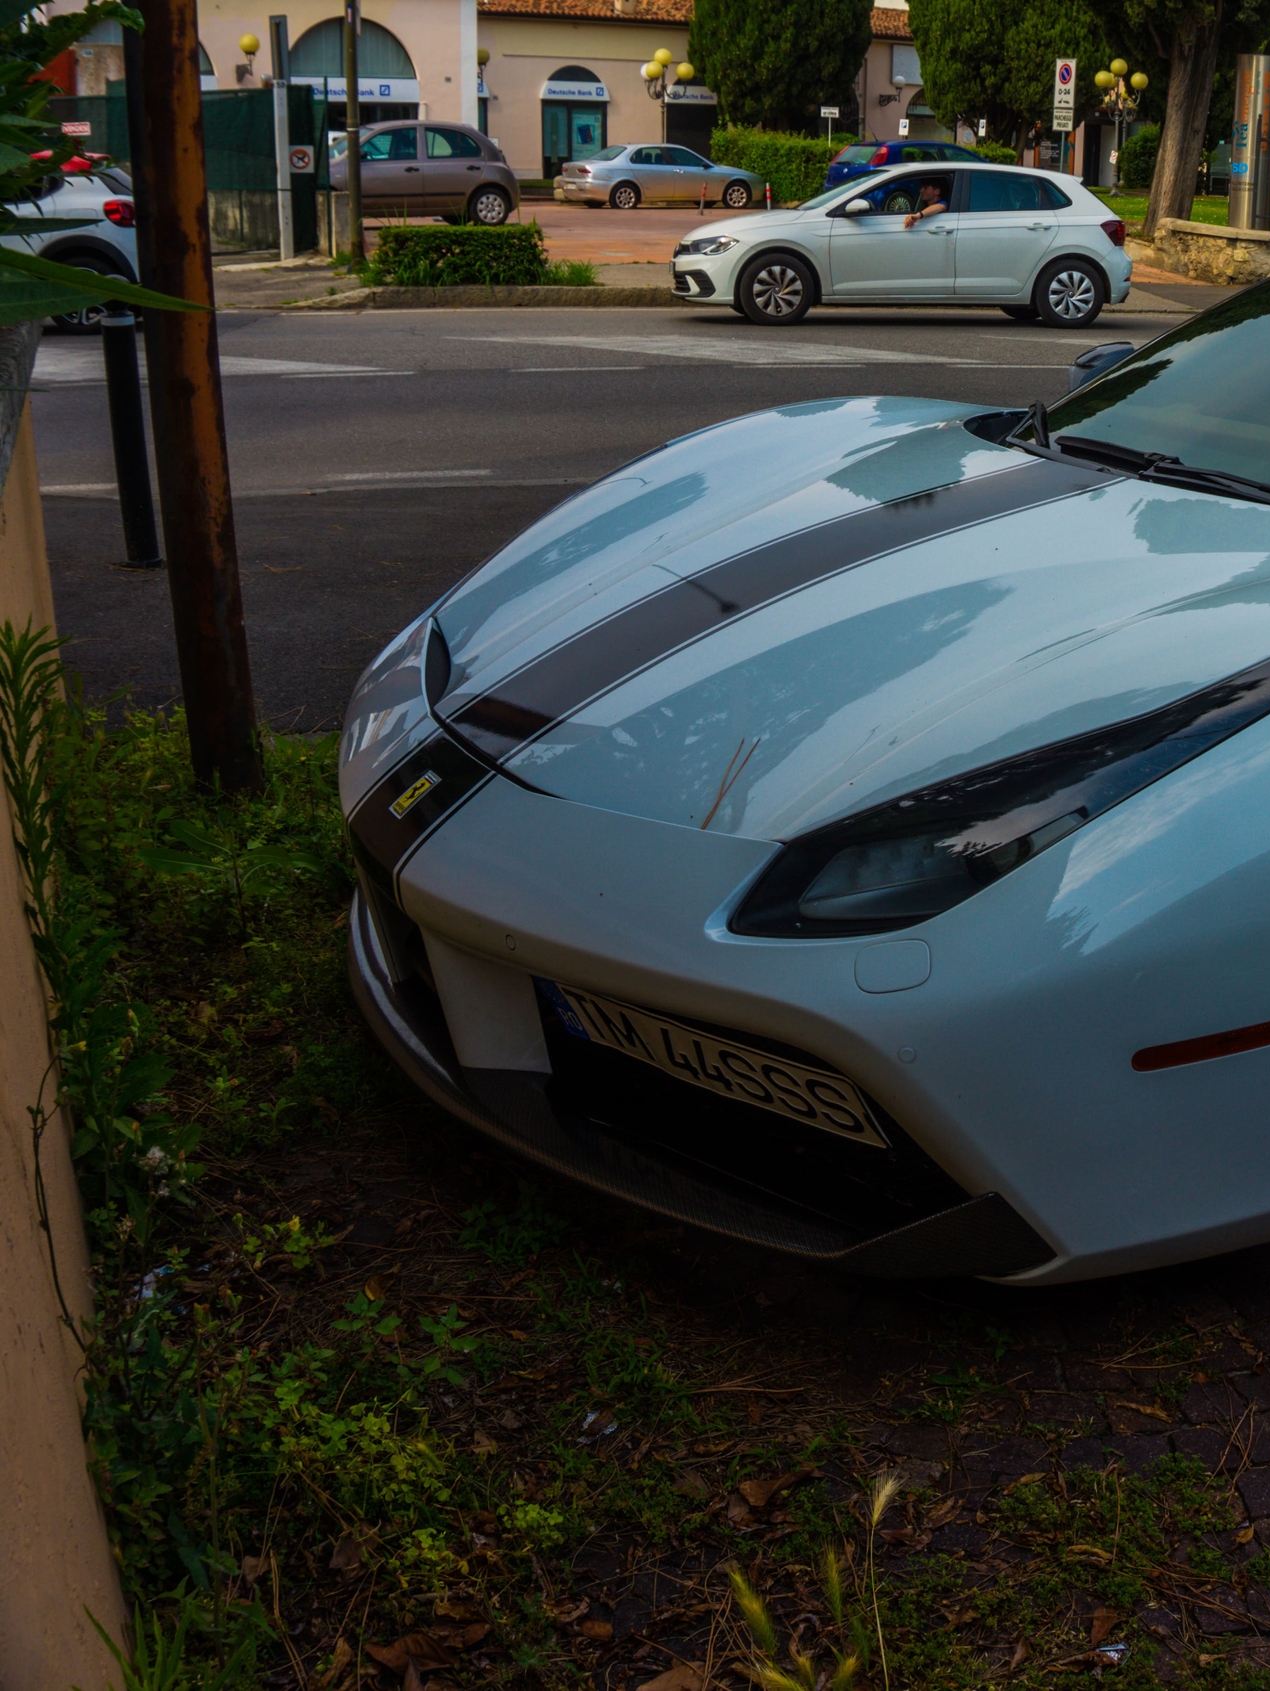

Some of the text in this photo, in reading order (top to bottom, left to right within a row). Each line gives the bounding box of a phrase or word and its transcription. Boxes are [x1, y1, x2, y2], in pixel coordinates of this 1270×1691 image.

[548, 88, 576, 96] Deutsche
[561, 1008, 583, 1031] RO
[561, 987, 657, 1062] TM
